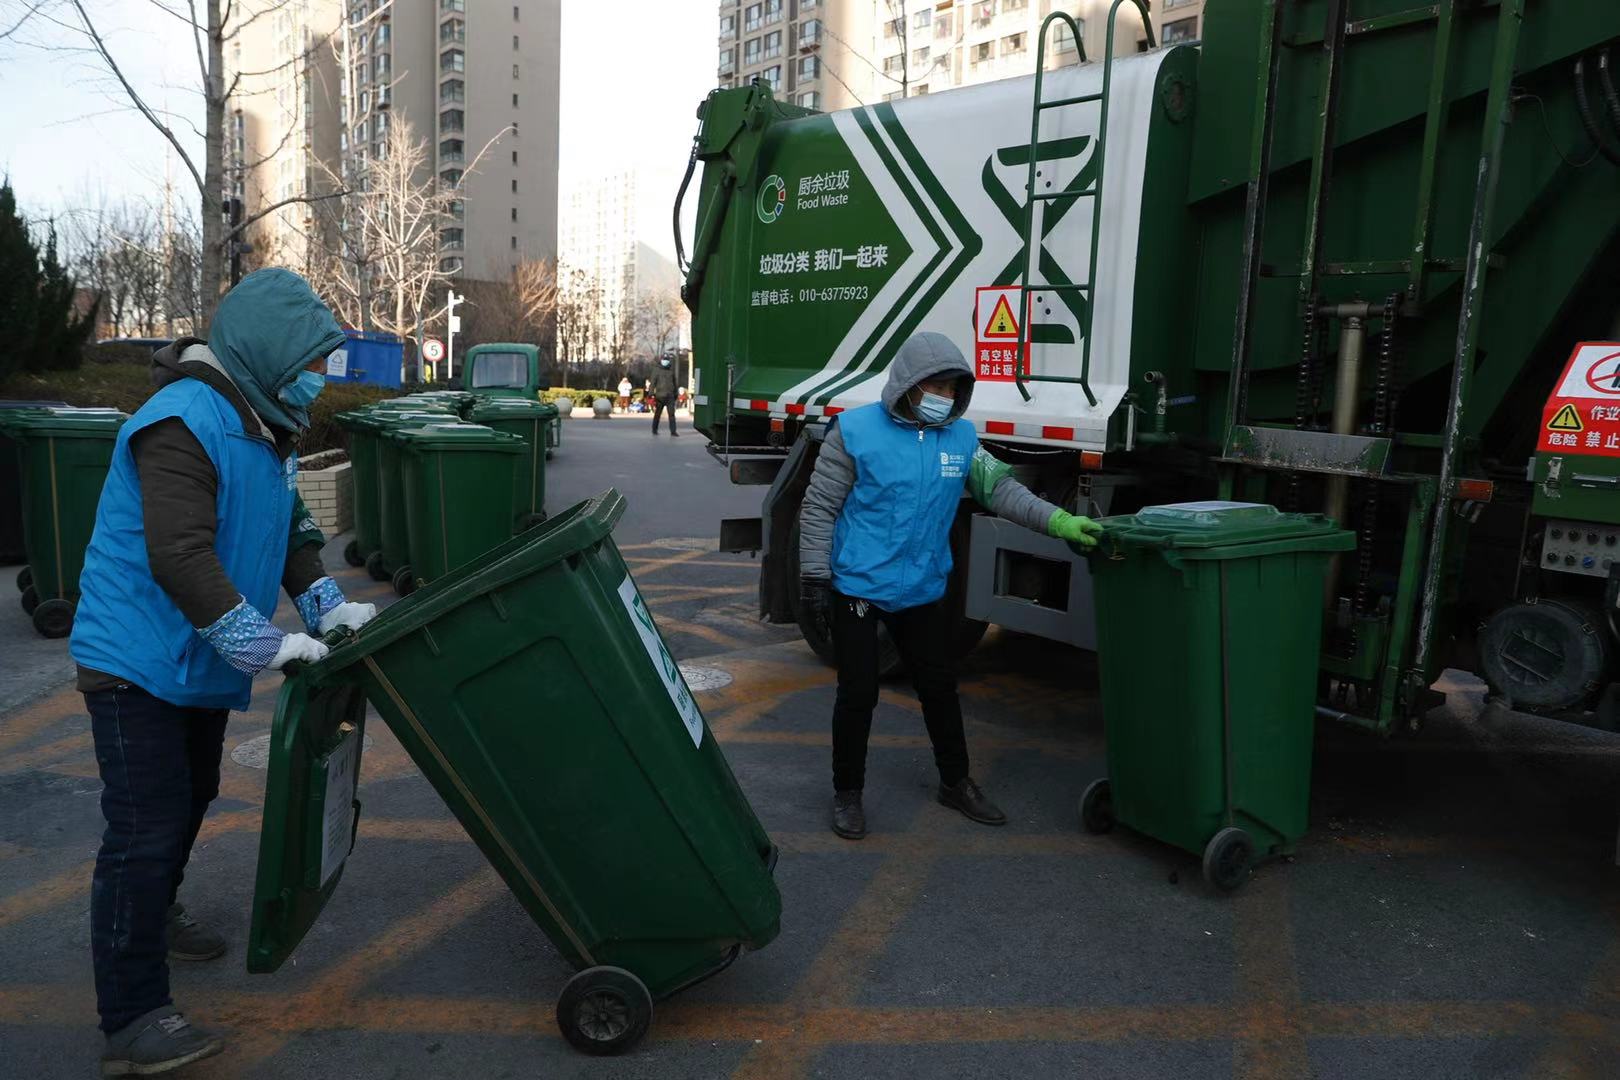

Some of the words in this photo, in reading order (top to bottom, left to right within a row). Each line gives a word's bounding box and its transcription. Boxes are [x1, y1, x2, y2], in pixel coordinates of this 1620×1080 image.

[798, 170, 849, 195] 厨余垃圾
[797, 197, 819, 210] Food
[821, 194, 848, 207] Waste
[760, 251, 809, 275] 垃圾分类
[814, 244, 888, 271] 我们一起来
[799, 286, 868, 301] 010-63775923
[430, 345, 438, 356] 5
[980, 349, 1024, 362] 高空坠
[980, 363, 1025, 376] 防止砸
[1591, 405, 1620, 420] 作业
[1548, 432, 1578, 446] 危险
